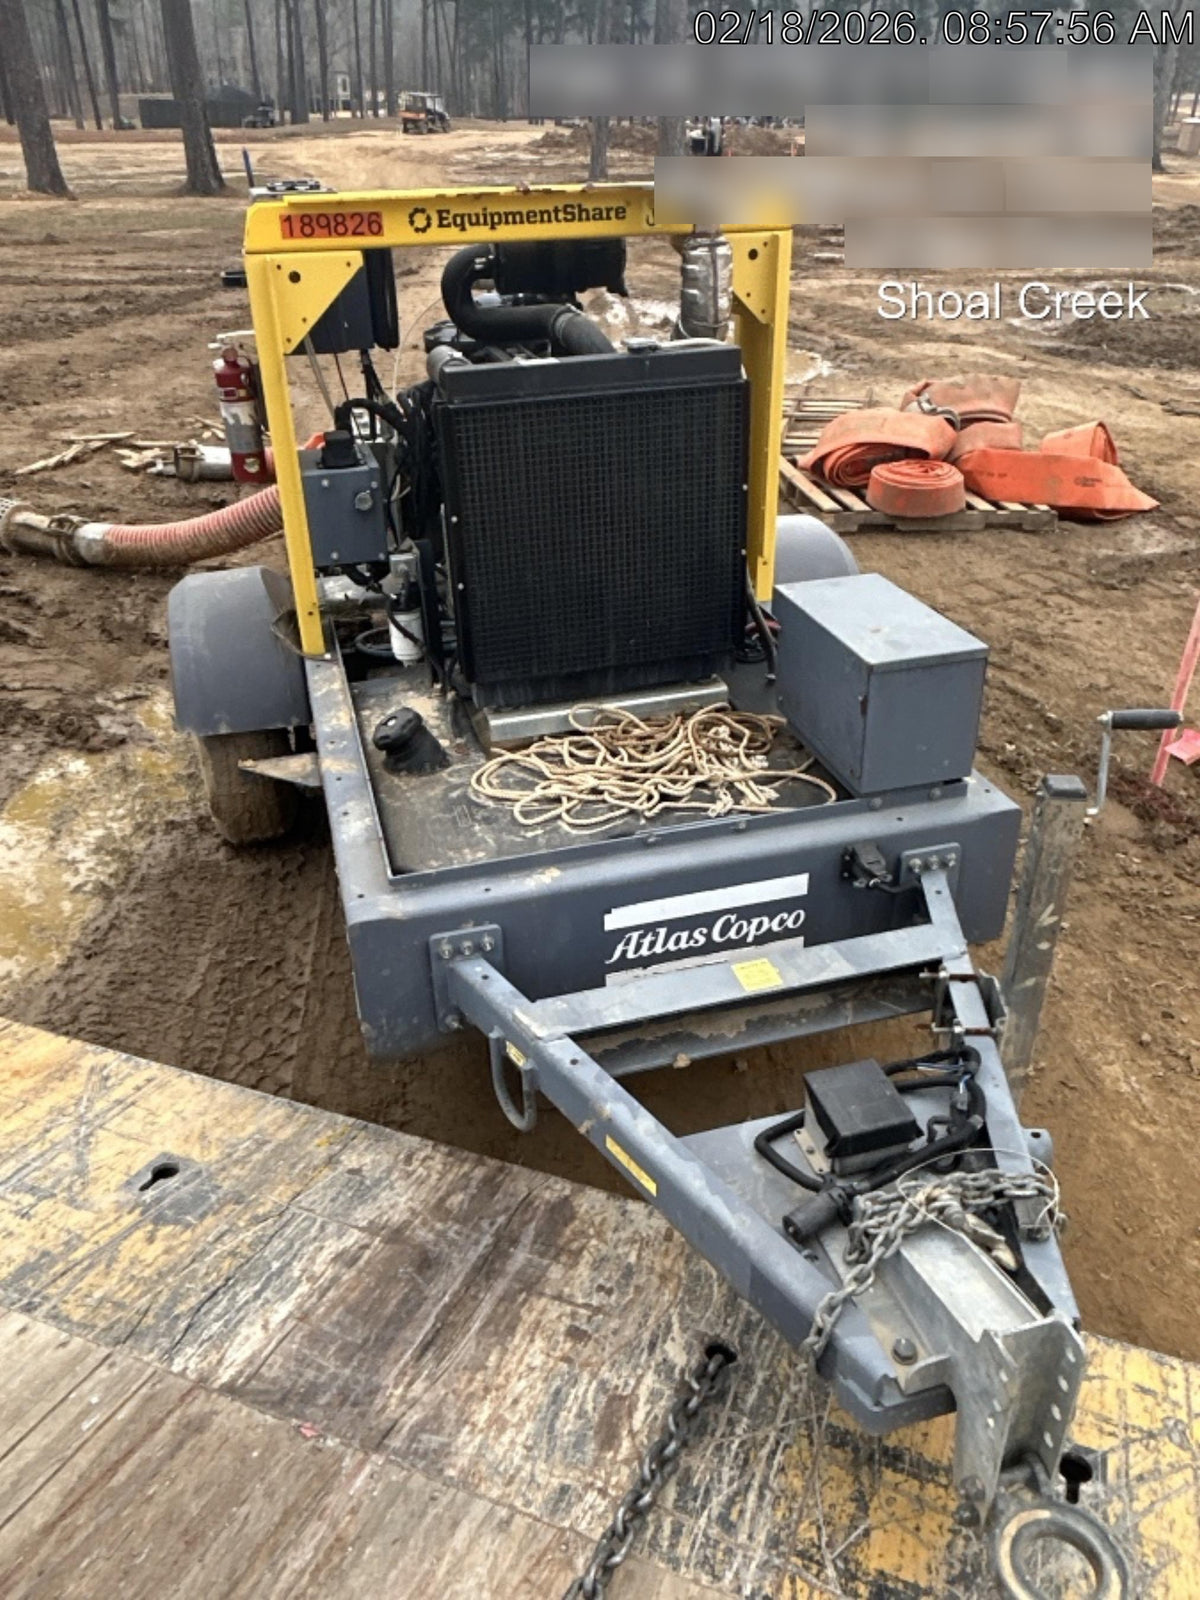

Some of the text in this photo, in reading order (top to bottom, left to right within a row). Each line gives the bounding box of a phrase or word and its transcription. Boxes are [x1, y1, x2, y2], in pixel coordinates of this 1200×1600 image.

[283, 212, 383, 237] 189826
[437, 203, 627, 231] EquipmentShare
[605, 909, 806, 964] Atlas Copco
